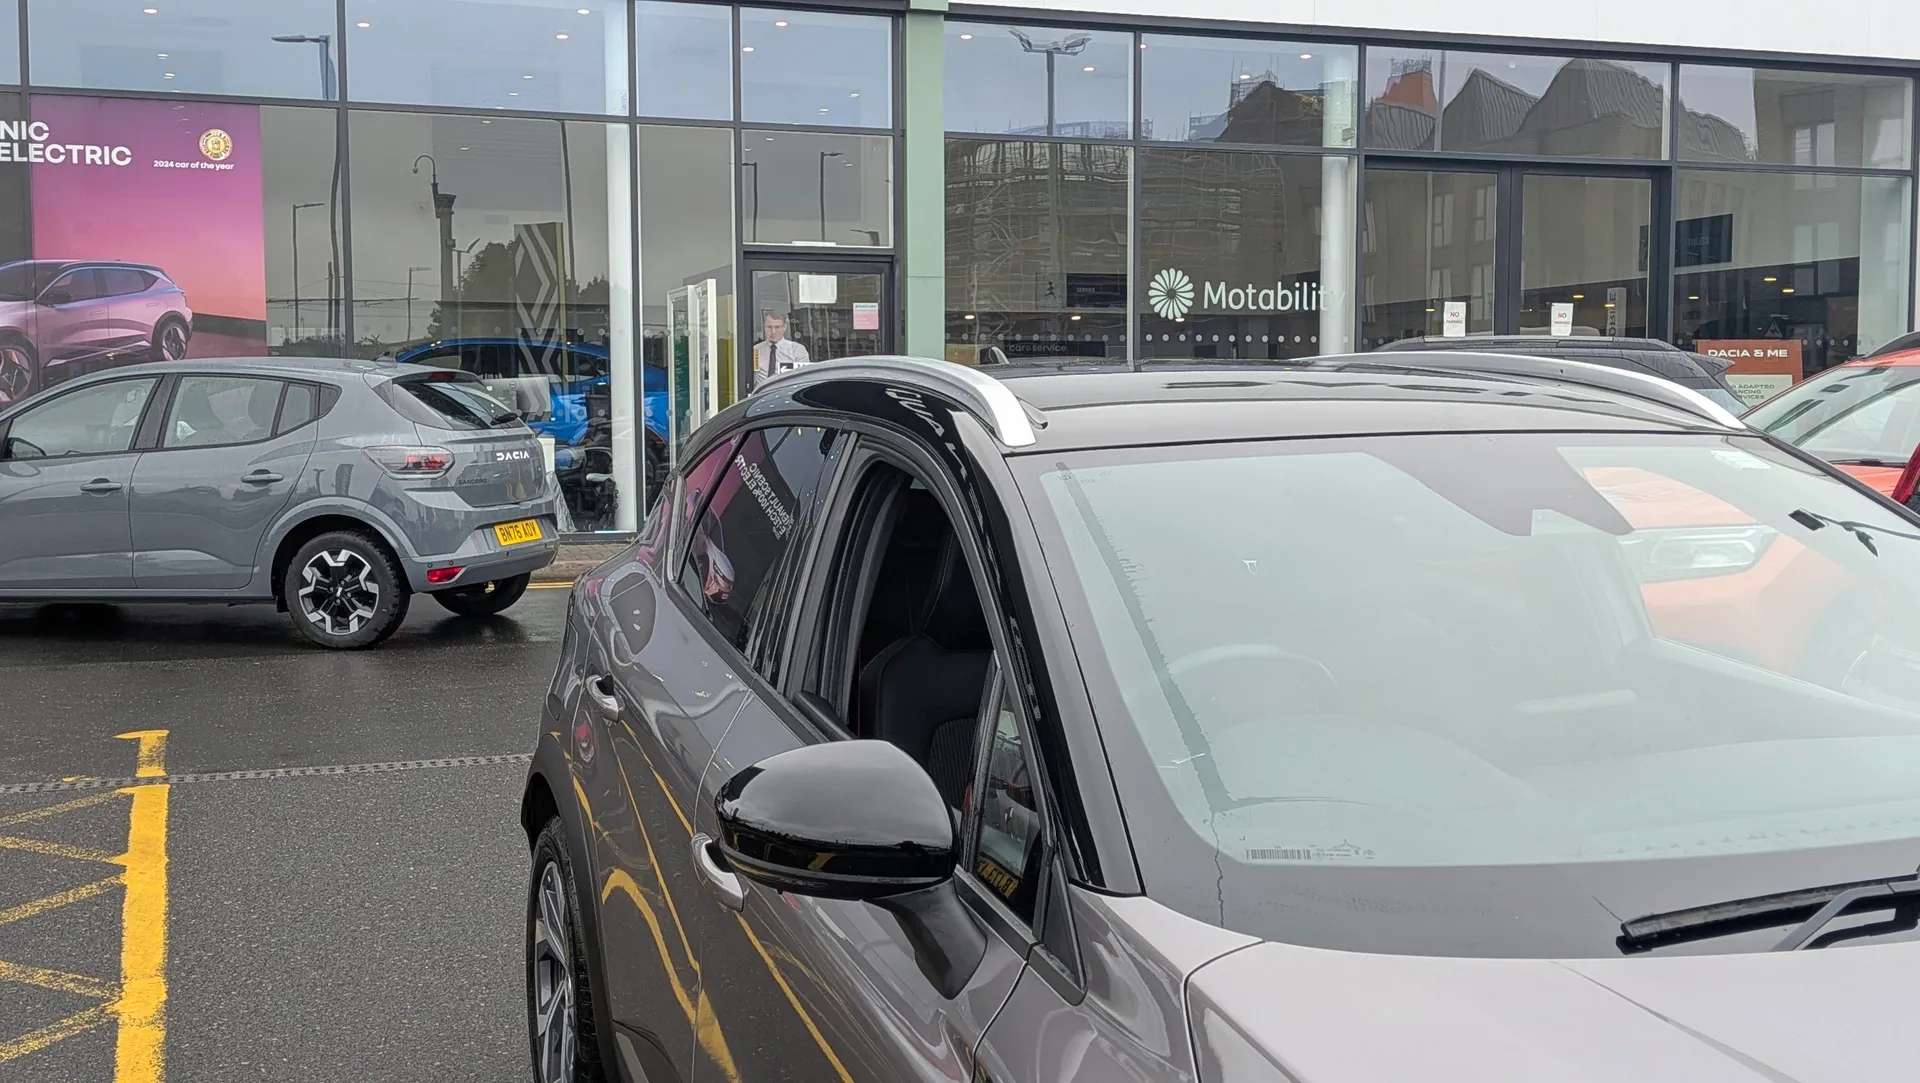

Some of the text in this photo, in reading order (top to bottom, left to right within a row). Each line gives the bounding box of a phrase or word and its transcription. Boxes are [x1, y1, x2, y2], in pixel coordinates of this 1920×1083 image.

[0, 120, 50, 142] NIC
[0, 142, 132, 166] ELECTRIC
[153, 160, 235, 171] 2024 car of the year
[1203, 280, 1346, 311] Motability
[1707, 349, 1788, 358] DACIA & ME
[495, 450, 530, 461] DACIA
